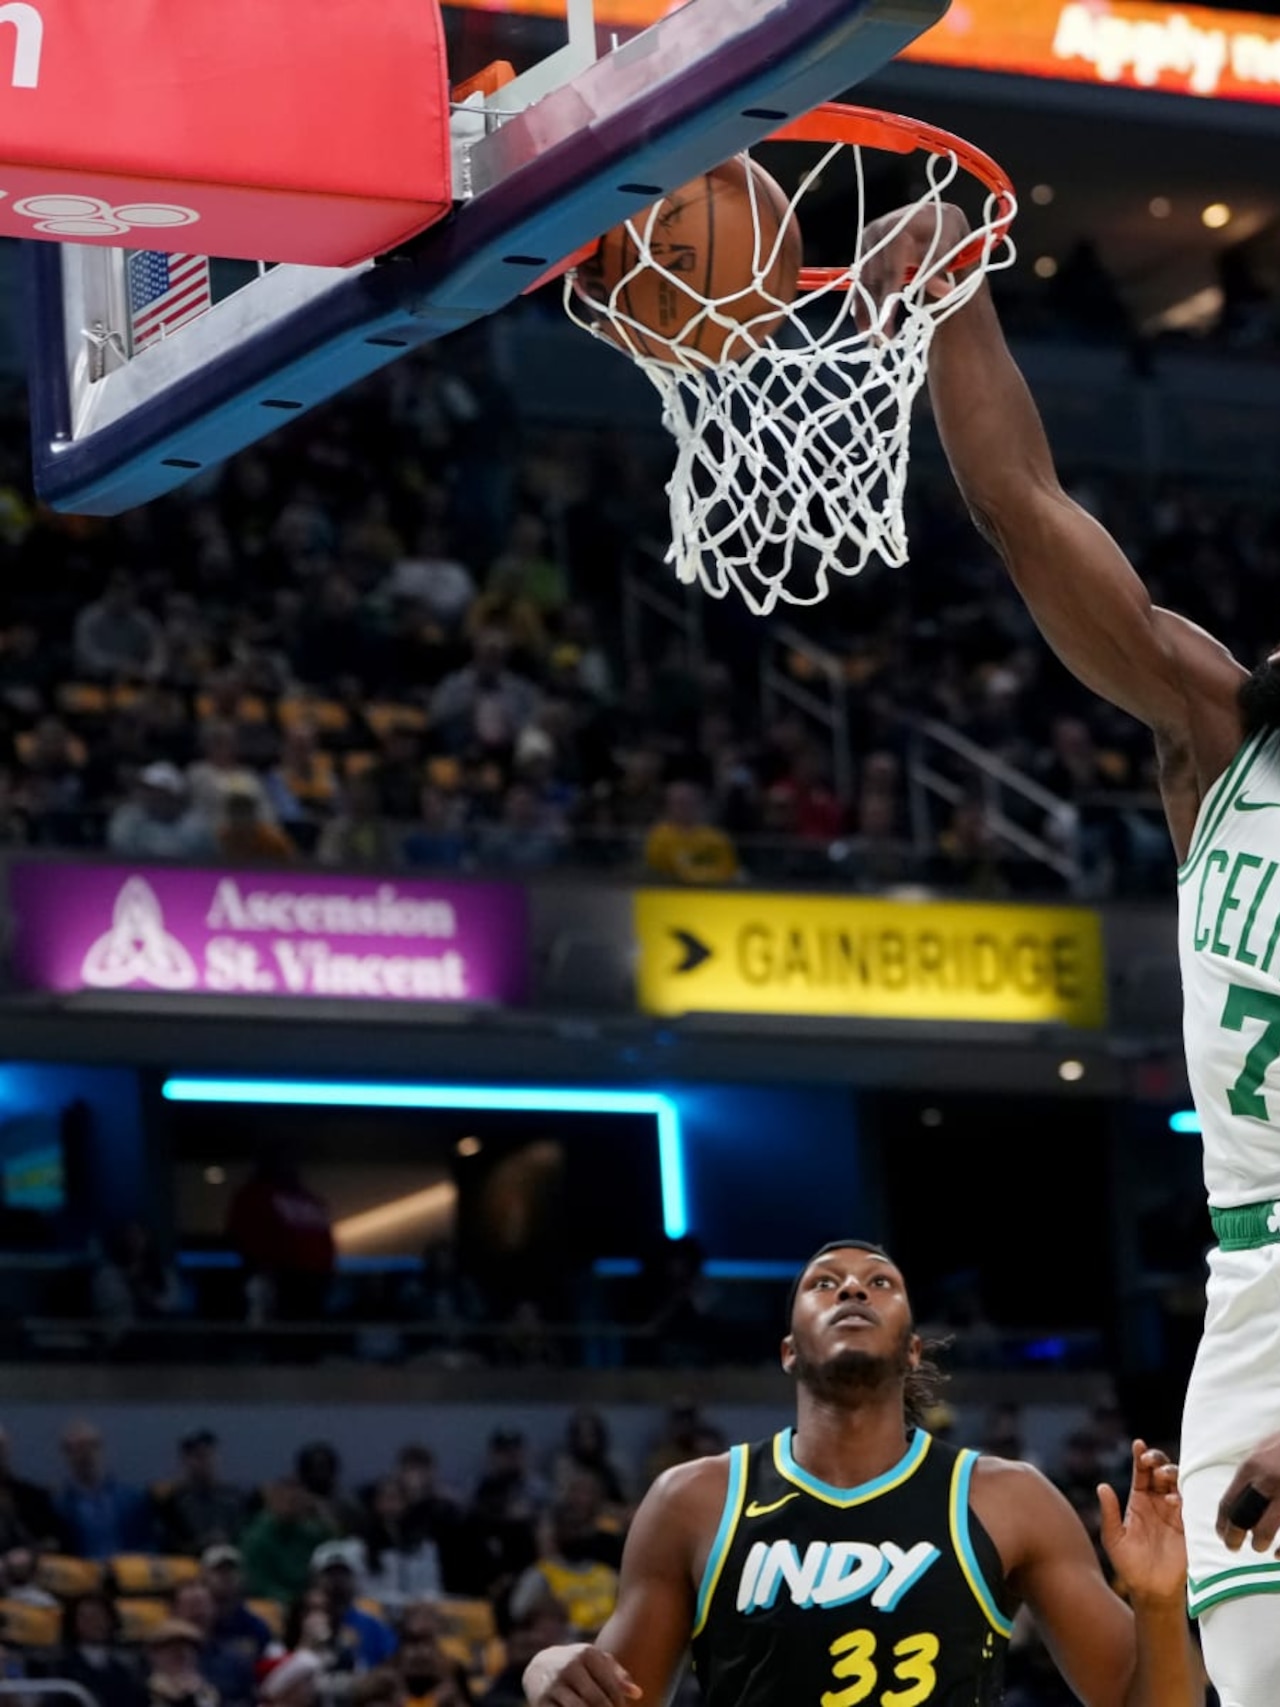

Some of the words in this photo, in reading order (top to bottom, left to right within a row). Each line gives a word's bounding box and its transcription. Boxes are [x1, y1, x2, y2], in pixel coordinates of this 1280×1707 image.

[1053, 4, 1226, 95] Apply
[206, 876, 457, 939] Ascension
[204, 936, 275, 991] St.
[273, 938, 467, 998] Vincent
[736, 922, 1077, 999] GAINBRIDGE
[736, 1539, 941, 1614] INDY
[820, 1628, 939, 1707] 33
